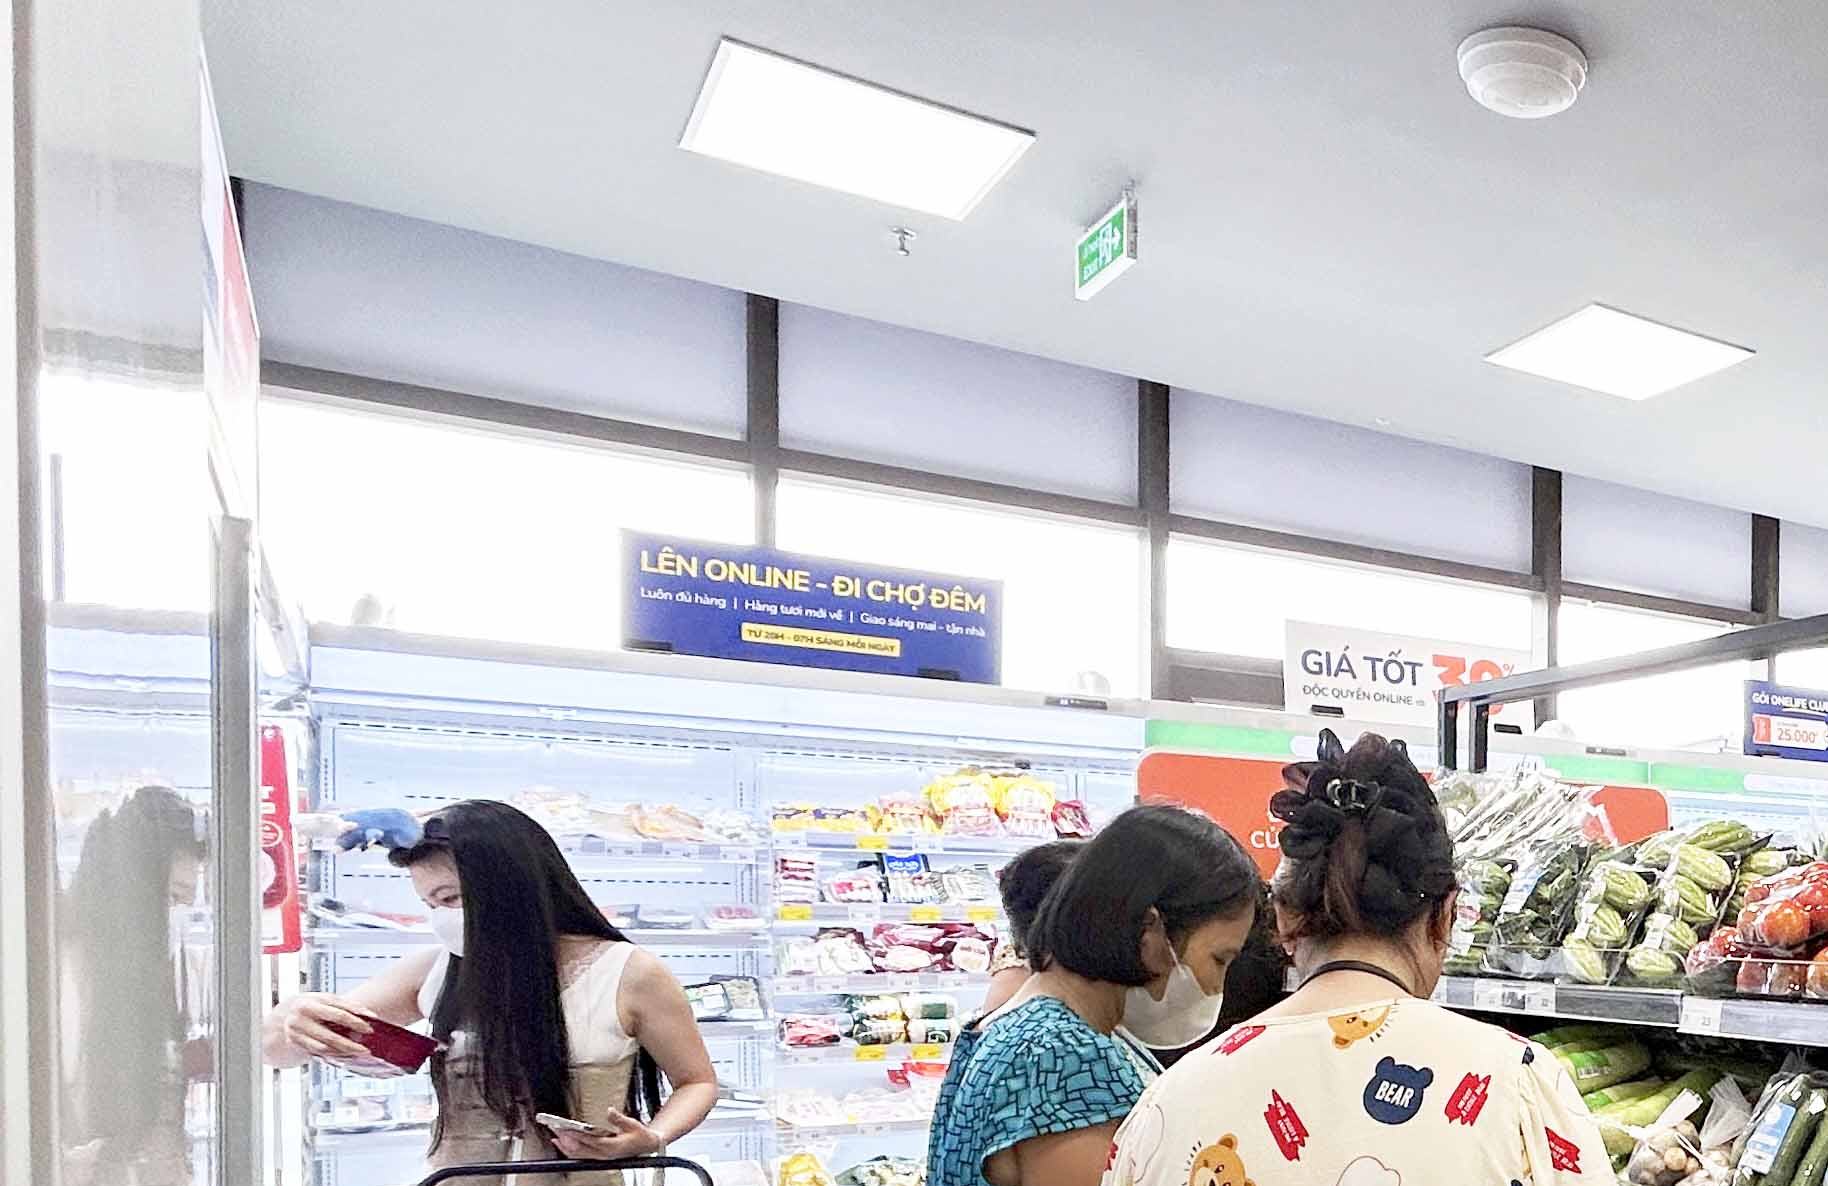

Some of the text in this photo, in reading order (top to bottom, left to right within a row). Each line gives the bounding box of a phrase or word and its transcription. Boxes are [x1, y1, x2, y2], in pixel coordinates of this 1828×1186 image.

[640, 546, 698, 578] LÊN
[704, 558, 811, 592] ONLINE
[832, 575, 861, 599] ĐI
[866, 579, 926, 611] CHỢ
[928, 584, 986, 615] ĐÊM
[640, 587, 673, 601] Luôn
[860, 612, 887, 626] Giao
[1301, 645, 1358, 680] GIÁ
[1373, 692, 1414, 706] ONLINE
[1375, 1081, 1414, 1108] BEAR
